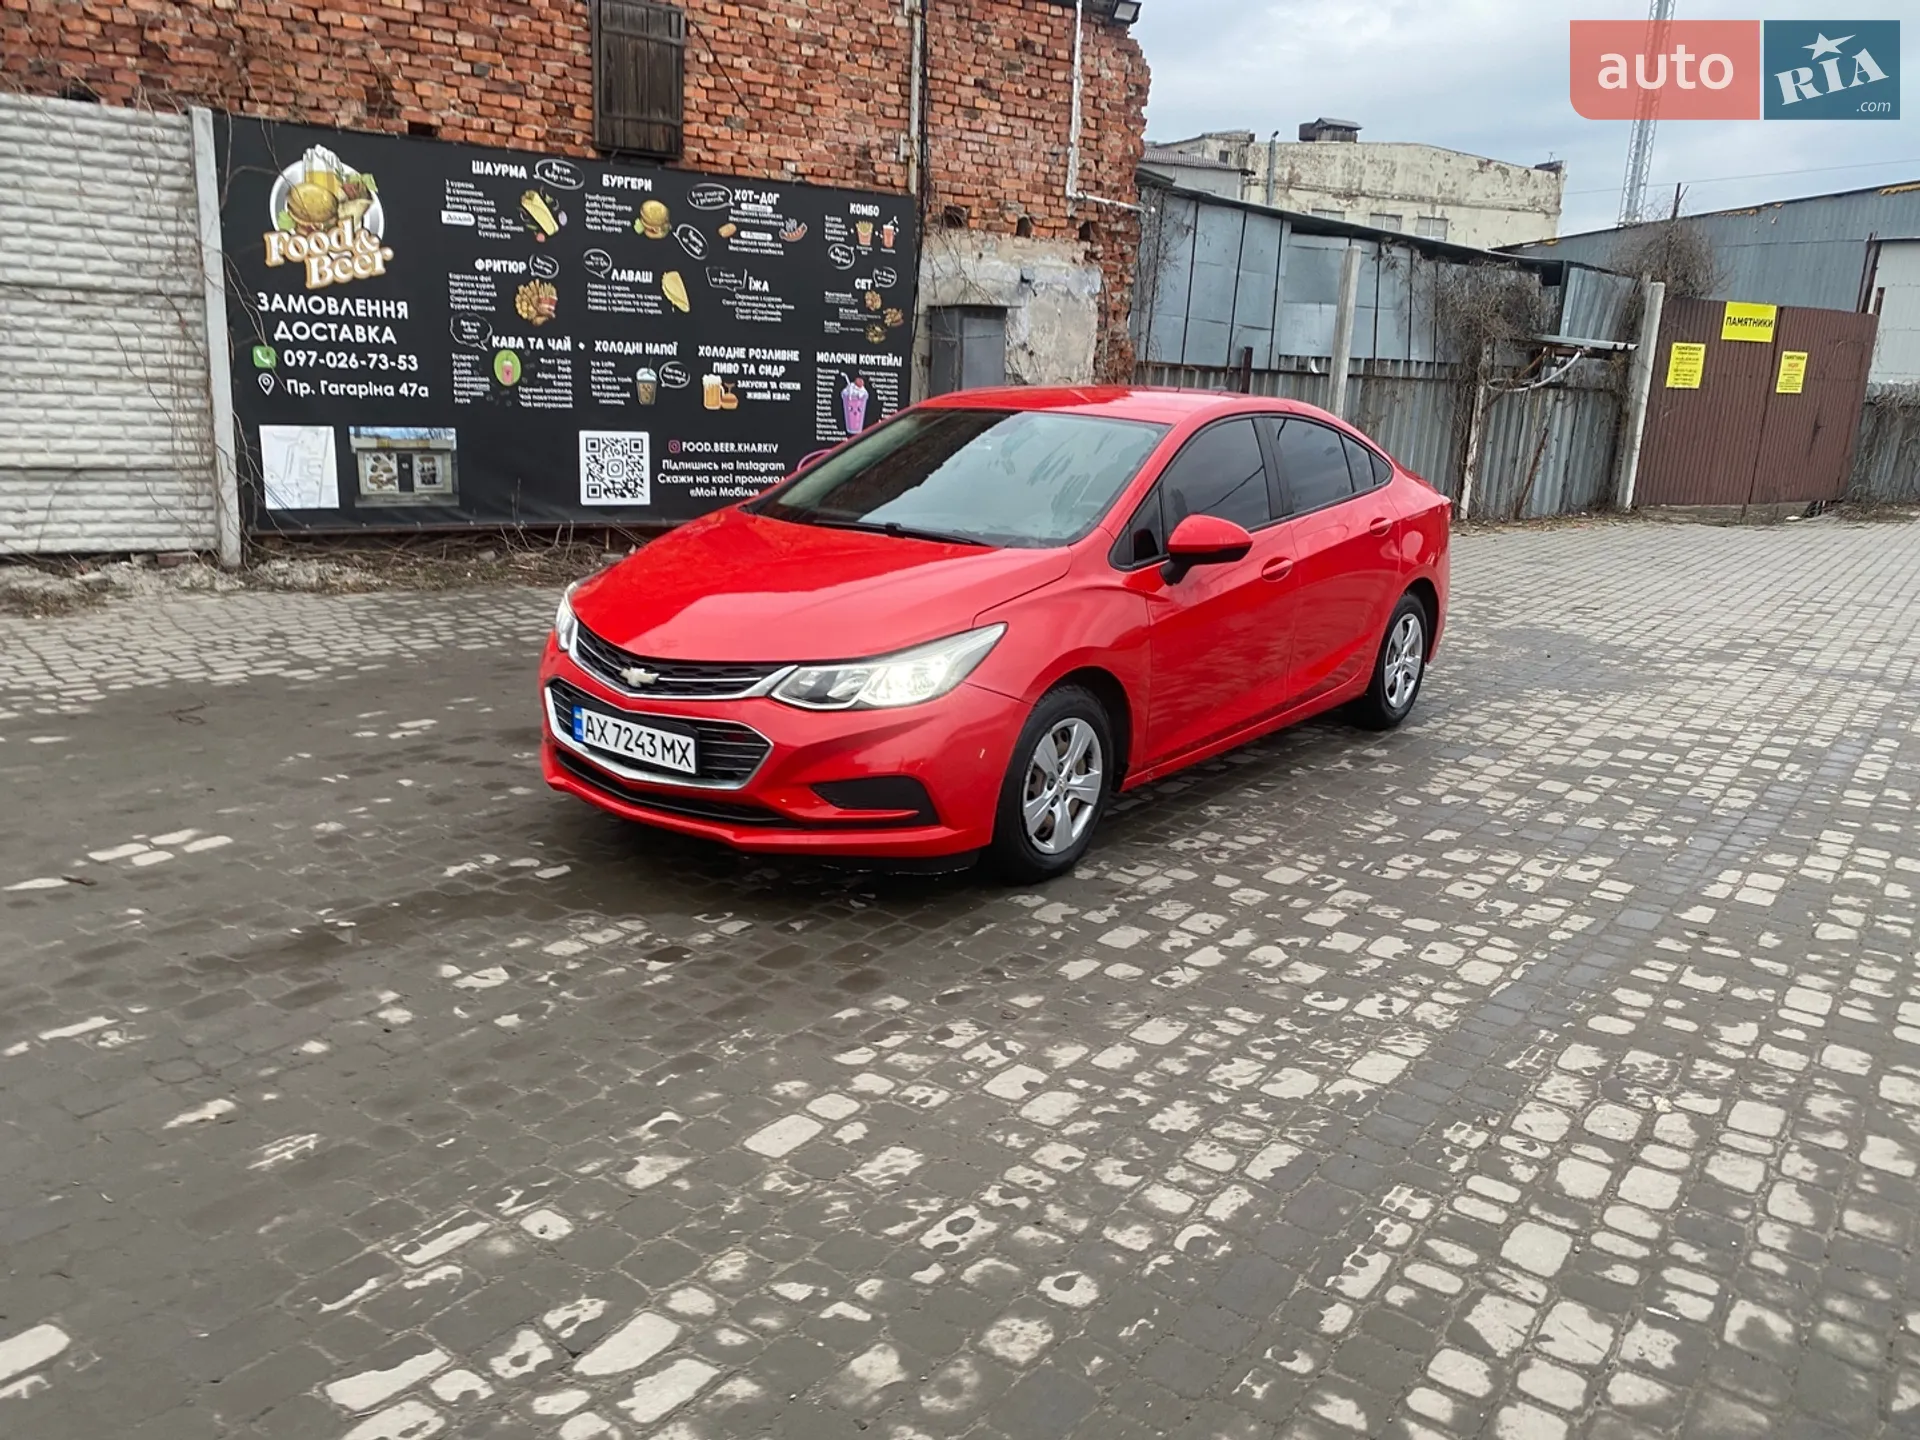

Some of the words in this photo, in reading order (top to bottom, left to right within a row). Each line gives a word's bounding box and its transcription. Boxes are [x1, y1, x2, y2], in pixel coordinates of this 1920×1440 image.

[471, 160, 528, 180] ШАУРМА
[602, 174, 652, 192] БУРГЕРИ
[734, 188, 780, 206] ХОТ-ДОГ
[849, 202, 880, 217] КОМБО
[264, 217, 355, 267] Food
[355, 228, 380, 255] &
[304, 248, 394, 290] Beer
[475, 258, 527, 274] ФРИТЮР
[611, 268, 653, 284] ЛАВАШ
[748, 276, 770, 292] ЇЖА
[855, 278, 873, 290] СЕТ
[257, 292, 409, 320] ЗАМОВЛЕННЯ
[1726, 316, 1773, 328] ПАМЯТНИКИ
[273, 320, 398, 345] ДОСТАВКА
[492, 335, 524, 349] КАВА
[528, 337, 544, 350] ТА
[547, 335, 571, 351] ЧАЙ
[594, 340, 643, 355] ХОЛОДНІ
[645, 341, 678, 356] НАПОЇ
[284, 349, 419, 372] 097-026-73-53
[698, 345, 746, 360] ХОЛОДНЕ
[749, 348, 800, 361] РОЗЛИВНЕ
[816, 352, 857, 365] МОЛОЧНІ
[859, 353, 902, 367] КОКТЕЙЛІ
[713, 362, 740, 375] ПИВО
[742, 363, 756, 375] ТА
[759, 364, 786, 378] СИДР
[286, 379, 316, 398] Пр.
[320, 379, 395, 399] Гагаріна
[399, 382, 429, 398] 47а
[737, 380, 768, 389] ЗАКУСКИ
[769, 381, 777, 389] ТА
[779, 381, 801, 390] СНЕКИ
[746, 390, 771, 400] ЖИВИЙ
[772, 392, 791, 401] КВАС
[682, 441, 779, 453] FOOD.BEER.KHARKIV
[662, 459, 719, 471] Підпишись
[721, 462, 734, 470] на
[736, 460, 785, 472] Instagram
[657, 473, 693, 484] Скажи
[696, 476, 709, 484] на
[711, 473, 733, 484] касі
[689, 487, 717, 497] «Мой
[612, 722, 657, 758] 7243
